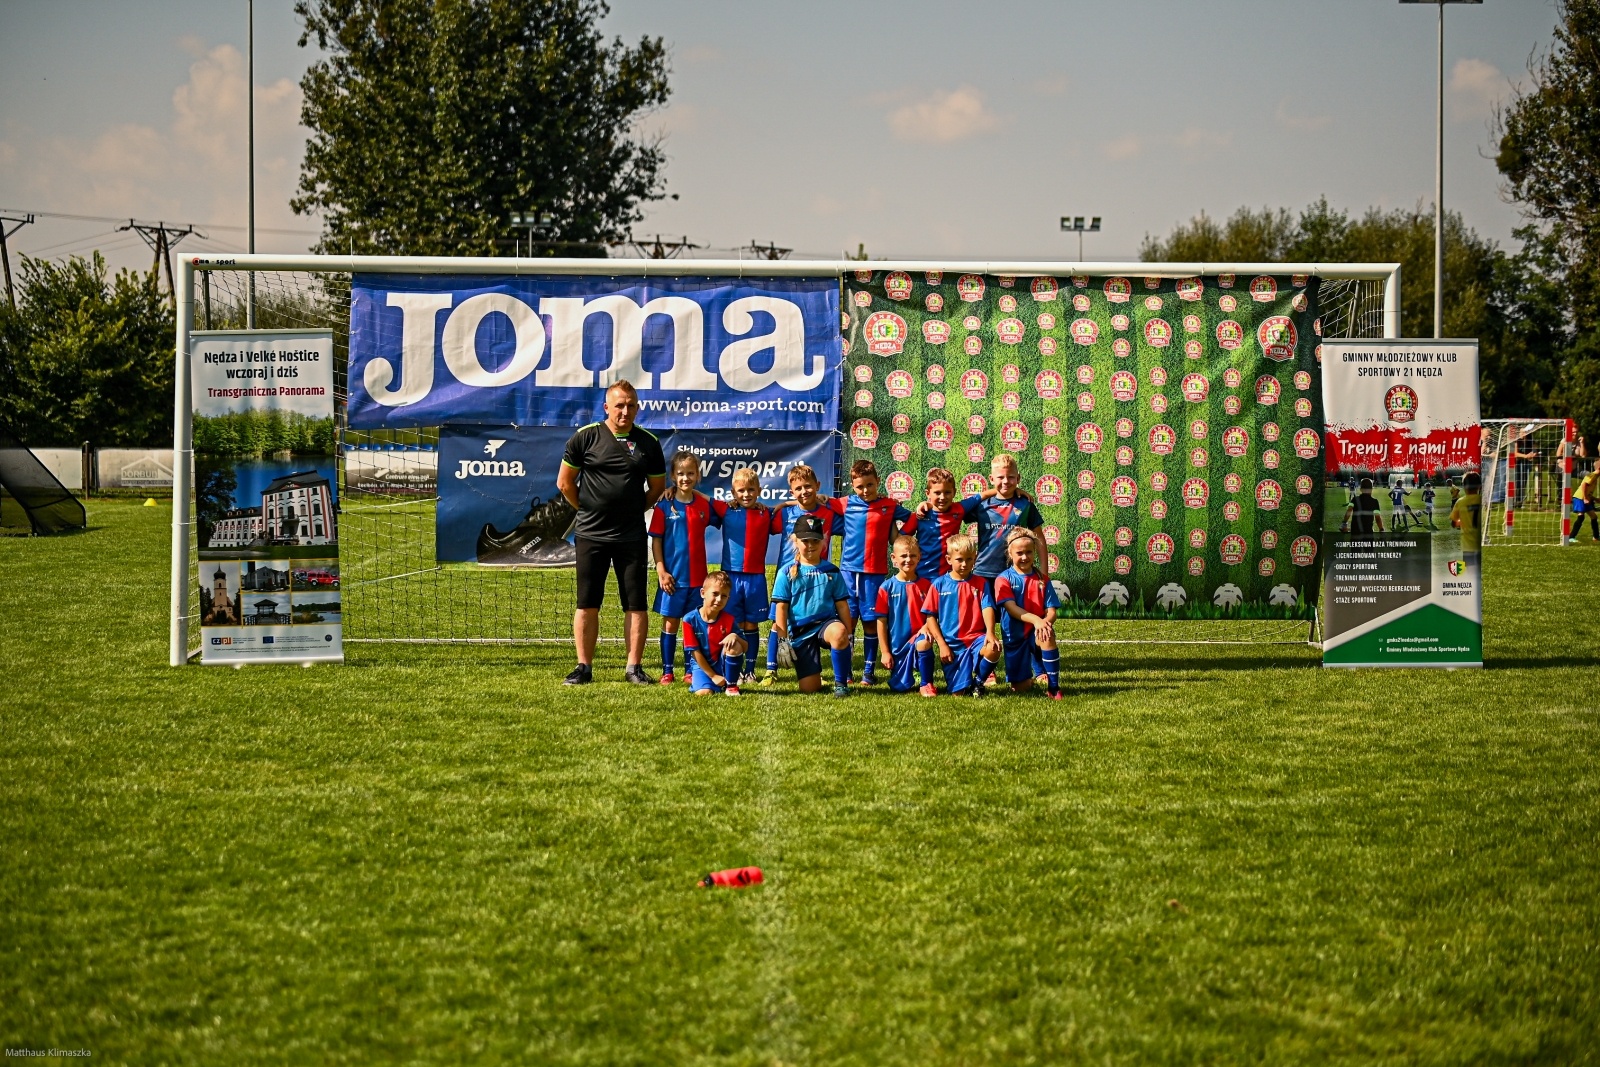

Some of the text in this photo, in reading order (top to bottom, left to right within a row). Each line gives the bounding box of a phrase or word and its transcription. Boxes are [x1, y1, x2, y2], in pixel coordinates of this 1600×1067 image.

[216, 258, 236, 266] sport
[204, 349, 319, 366] Nędza i Velké Hoštice
[1342, 351, 1457, 362] GMINNY MŁODZIEŻOWY KLUB
[226, 366, 298, 380] wczoraj i dziś
[1358, 367, 1443, 378] SPORTOWY 21 NĘDZA
[208, 386, 325, 399] Transgraniczna Panorama
[637, 397, 826, 416] www.joma-sport.com
[677, 445, 759, 458] Sklep sportowy
[1338, 438, 1388, 461] Trenuj
[1394, 443, 1403, 454] z
[1408, 440, 1447, 455] nami
[1451, 437, 1468, 455] !!!
[1457, 582, 1472, 590] NĘDZA
